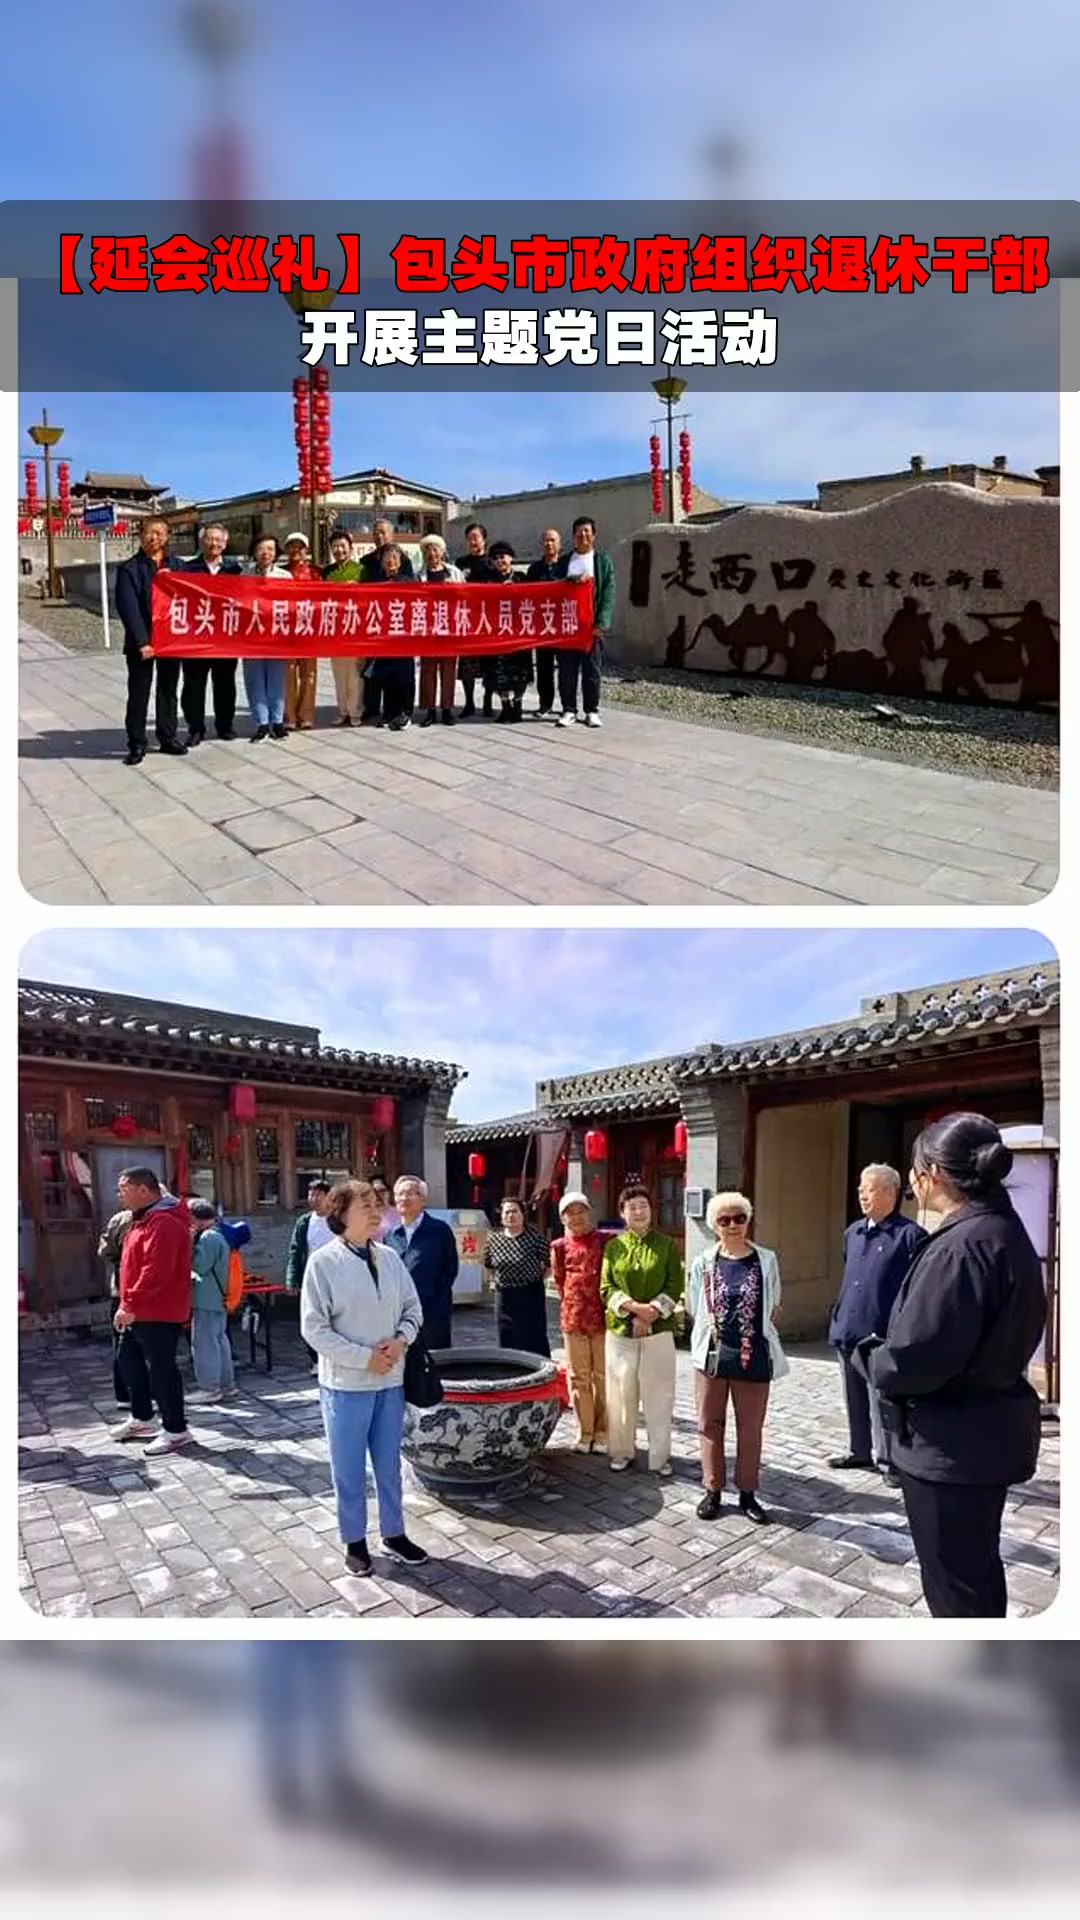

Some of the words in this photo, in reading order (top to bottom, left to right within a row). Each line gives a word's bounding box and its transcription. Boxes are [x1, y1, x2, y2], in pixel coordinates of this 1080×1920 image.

[169, 596, 579, 637] 包头市人民政府办公室离退休人员党支部
